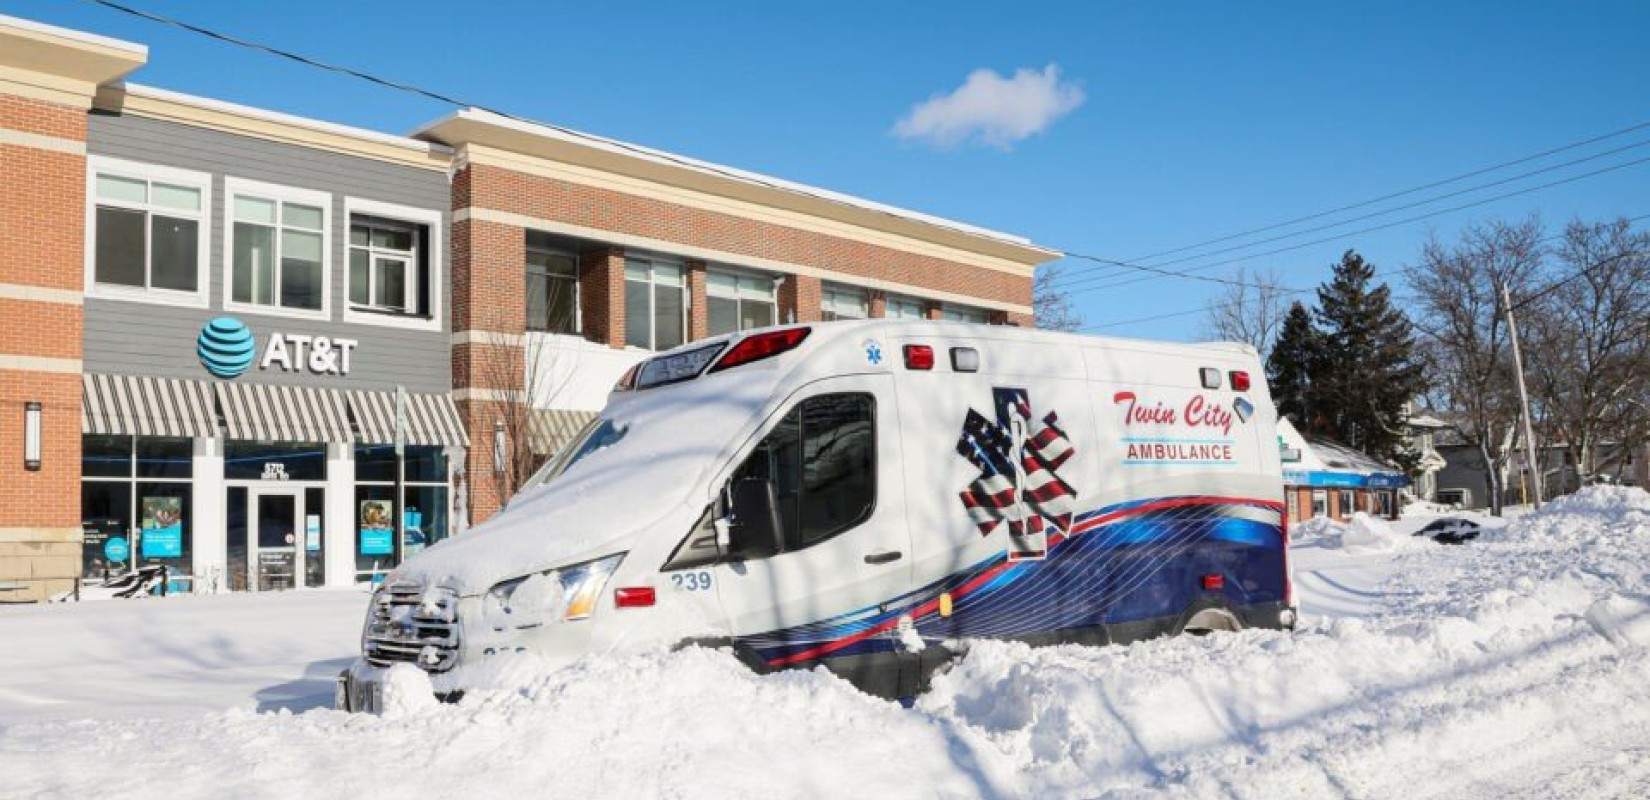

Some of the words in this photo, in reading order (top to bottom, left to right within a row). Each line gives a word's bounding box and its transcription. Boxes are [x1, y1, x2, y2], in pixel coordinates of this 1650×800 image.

[260, 332, 358, 374] AT&T
[1113, 391, 1176, 426] Twin
[1183, 394, 1232, 435] City
[1127, 443, 1233, 460] AMBULANCE
[671, 571, 711, 591] 239
